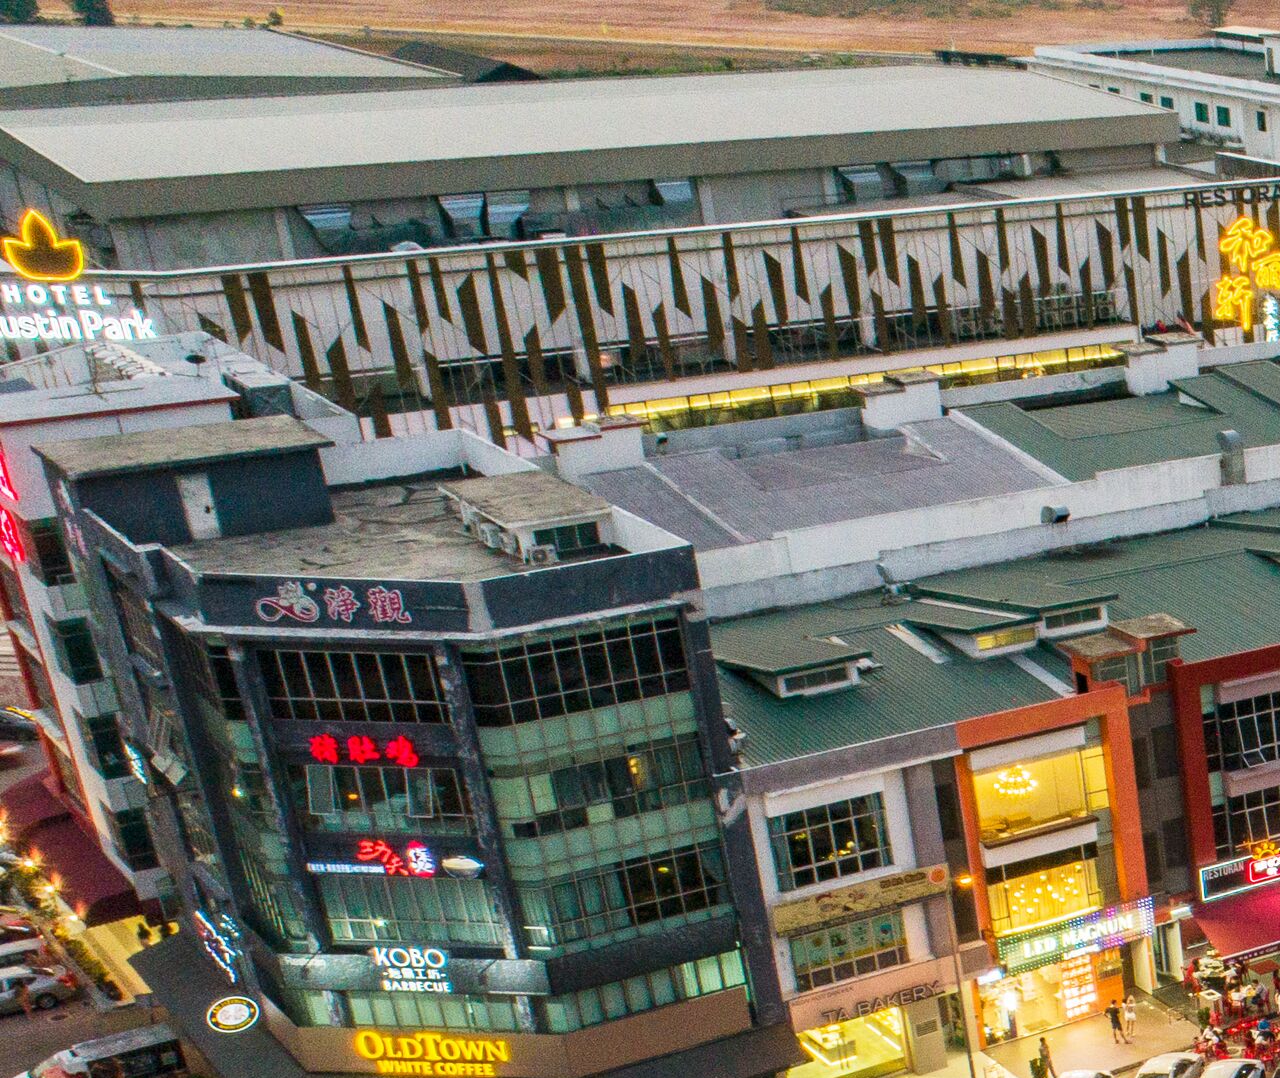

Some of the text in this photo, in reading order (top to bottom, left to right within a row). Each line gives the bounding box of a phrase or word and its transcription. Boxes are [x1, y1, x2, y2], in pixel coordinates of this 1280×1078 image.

[1, 284, 112, 306] HOTEL
[0, 309, 157, 340] ustin Park
[1202, 860, 1245, 881] RESTORAN
[1060, 914, 1136, 947] MAGNUM
[373, 945, 446, 969] KOBO
[382, 980, 452, 993] BARBECUE
[822, 979, 946, 1026] TA BAKERY
[376, 1060, 495, 1076] WHITE COFFEE
